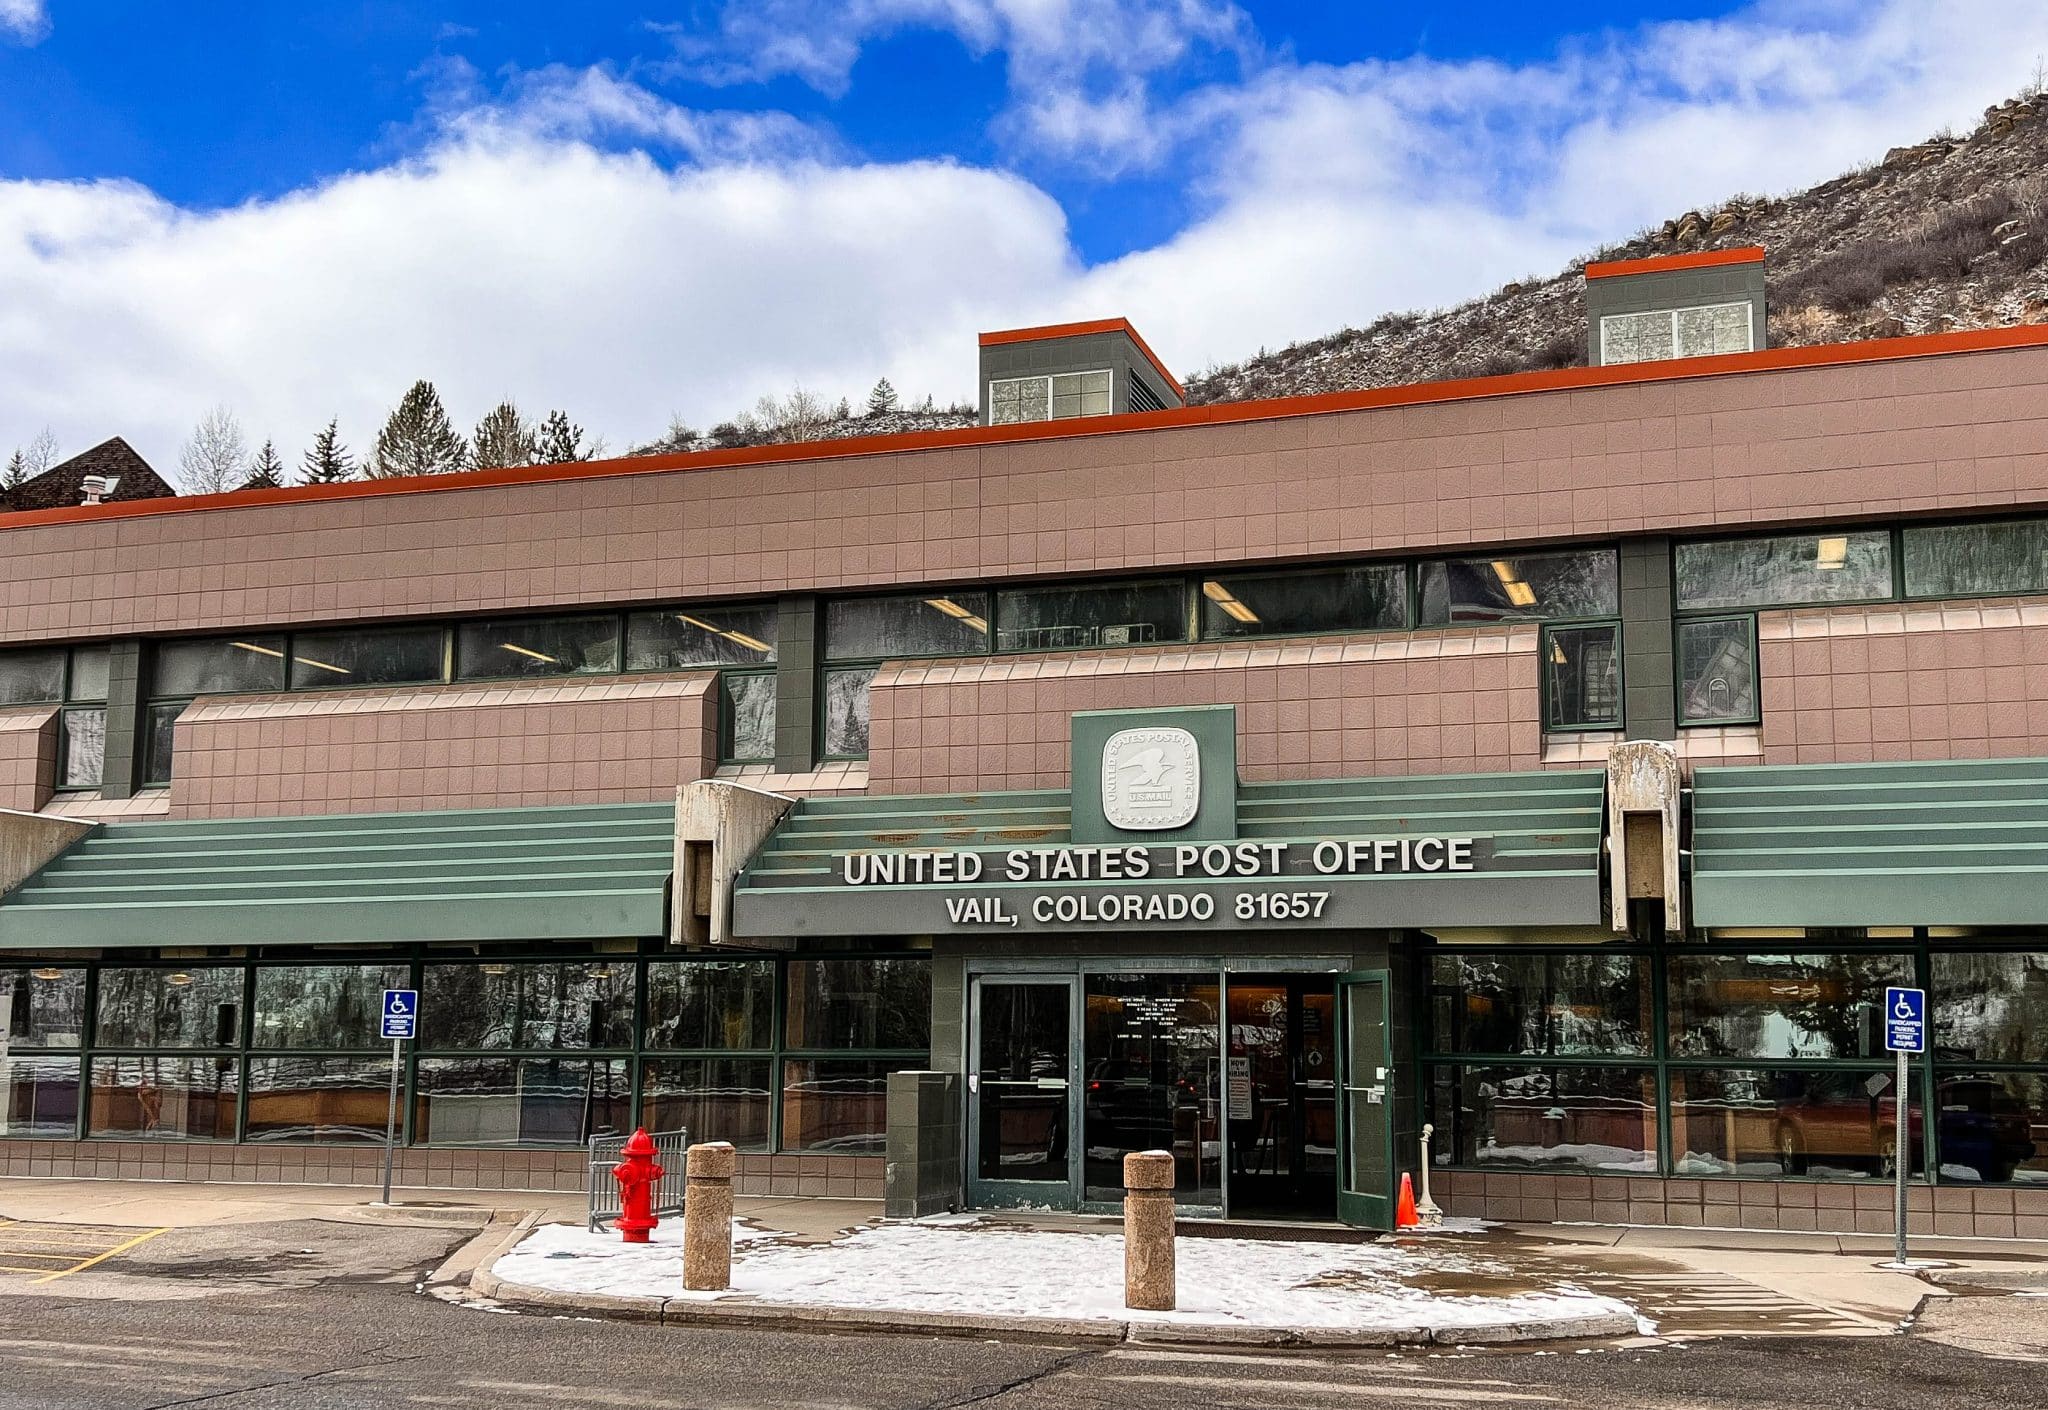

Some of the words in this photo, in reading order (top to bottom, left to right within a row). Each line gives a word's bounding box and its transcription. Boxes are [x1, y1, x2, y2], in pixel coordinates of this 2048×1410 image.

[1109, 733, 1146, 756] STATES
[1147, 733, 1190, 748] POSTAL
[1107, 758, 1117, 802] UNITED
[1183, 752, 1195, 800] SERVICE
[844, 852, 983, 885] UNITED
[1005, 846, 1150, 880] STATES
[1175, 842, 1288, 876] POST
[1312, 837, 1474, 874] OFFICE
[945, 897, 1018, 927] VAIL,
[1032, 893, 1214, 922] COLORADO
[1234, 891, 1329, 920] 81657
